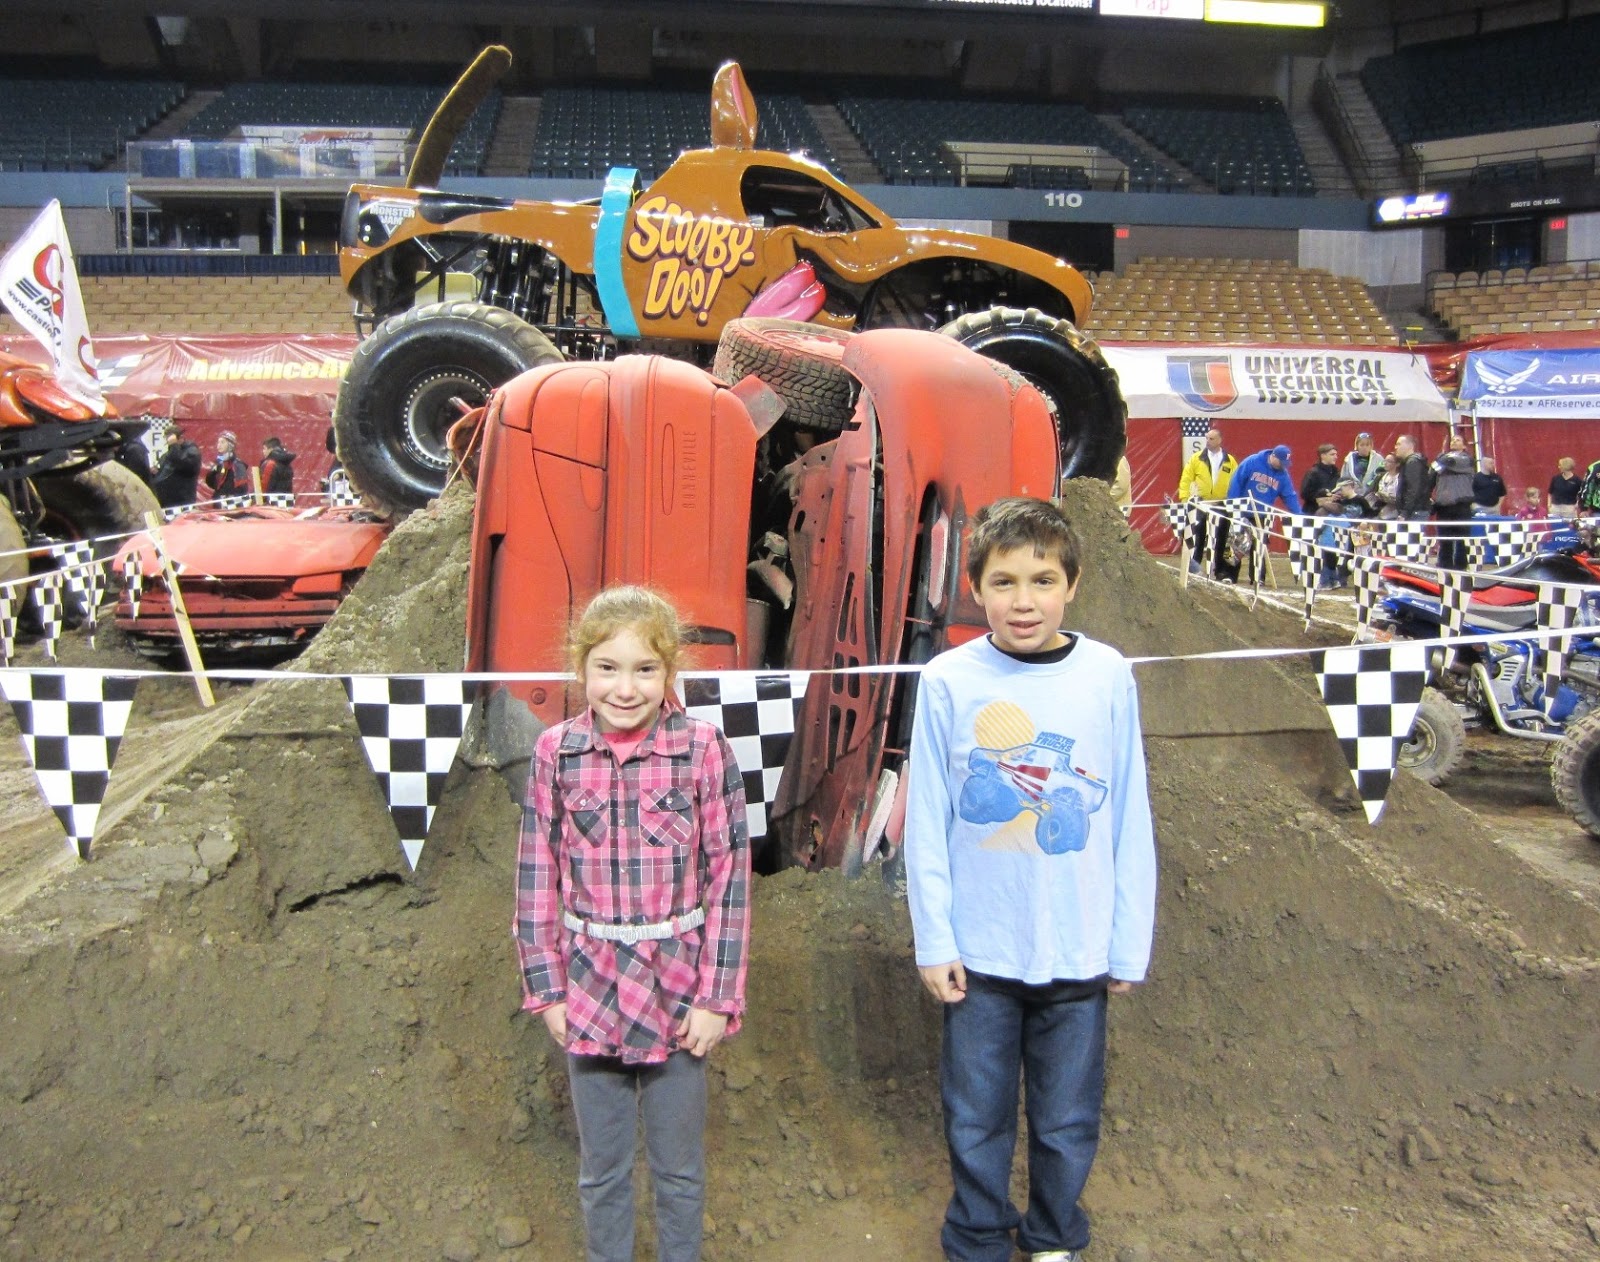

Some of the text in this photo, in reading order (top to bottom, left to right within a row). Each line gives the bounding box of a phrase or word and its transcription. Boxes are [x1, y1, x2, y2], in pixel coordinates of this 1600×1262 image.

[1045, 193, 1082, 208] 110
[370, 203, 415, 219] MONSTER
[381, 215, 404, 226] JAM
[1244, 356, 1386, 379] UNIVERSAL
[1249, 375, 1391, 392] TECHNICAL
[1257, 389, 1397, 405] INSTITUTE
[682, 431, 697, 509] BONNEVILLE
[1400, 566, 1438, 581] HOND
[1034, 736, 1073, 752] TRUCKS
[1038, 731, 1076, 747] MONSTER
